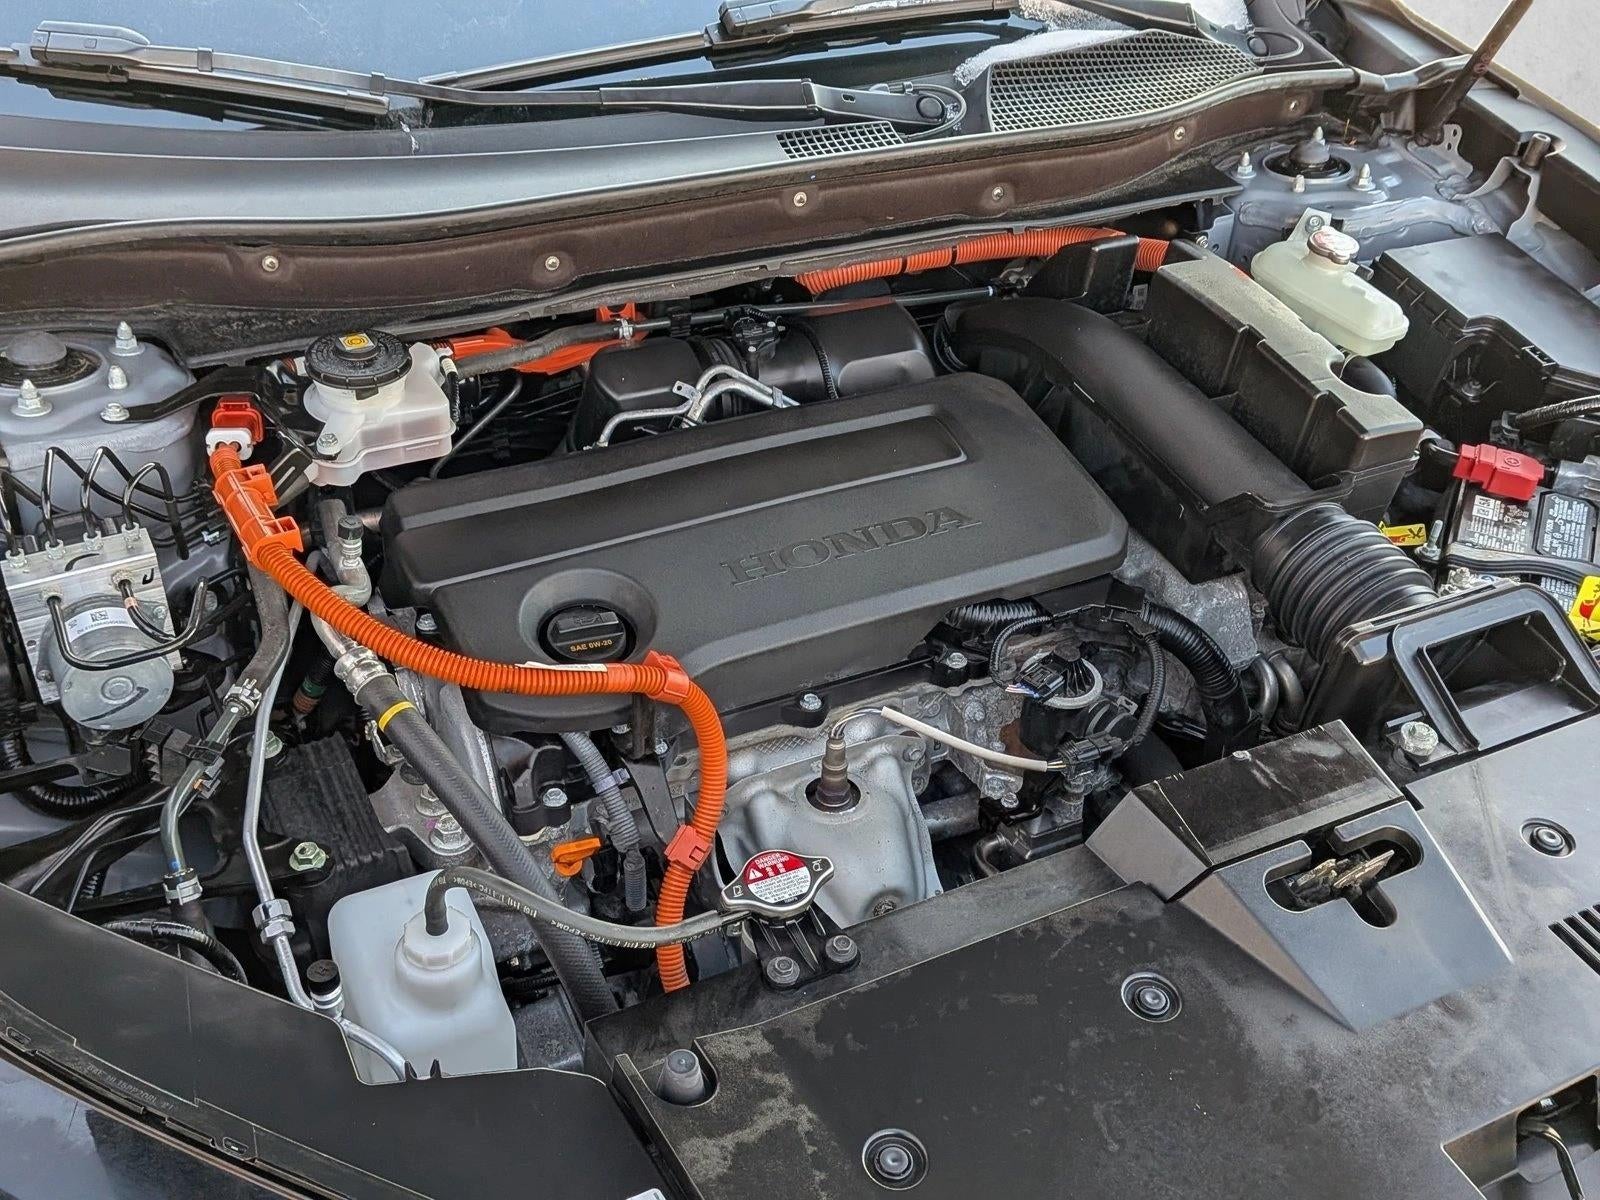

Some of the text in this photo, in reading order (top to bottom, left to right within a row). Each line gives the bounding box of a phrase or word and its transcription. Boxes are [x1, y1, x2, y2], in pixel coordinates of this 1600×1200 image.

[720, 506, 981, 586] HONDA
[570, 639, 613, 652] SAE 0W-20
[755, 853, 781, 865] DANGER
